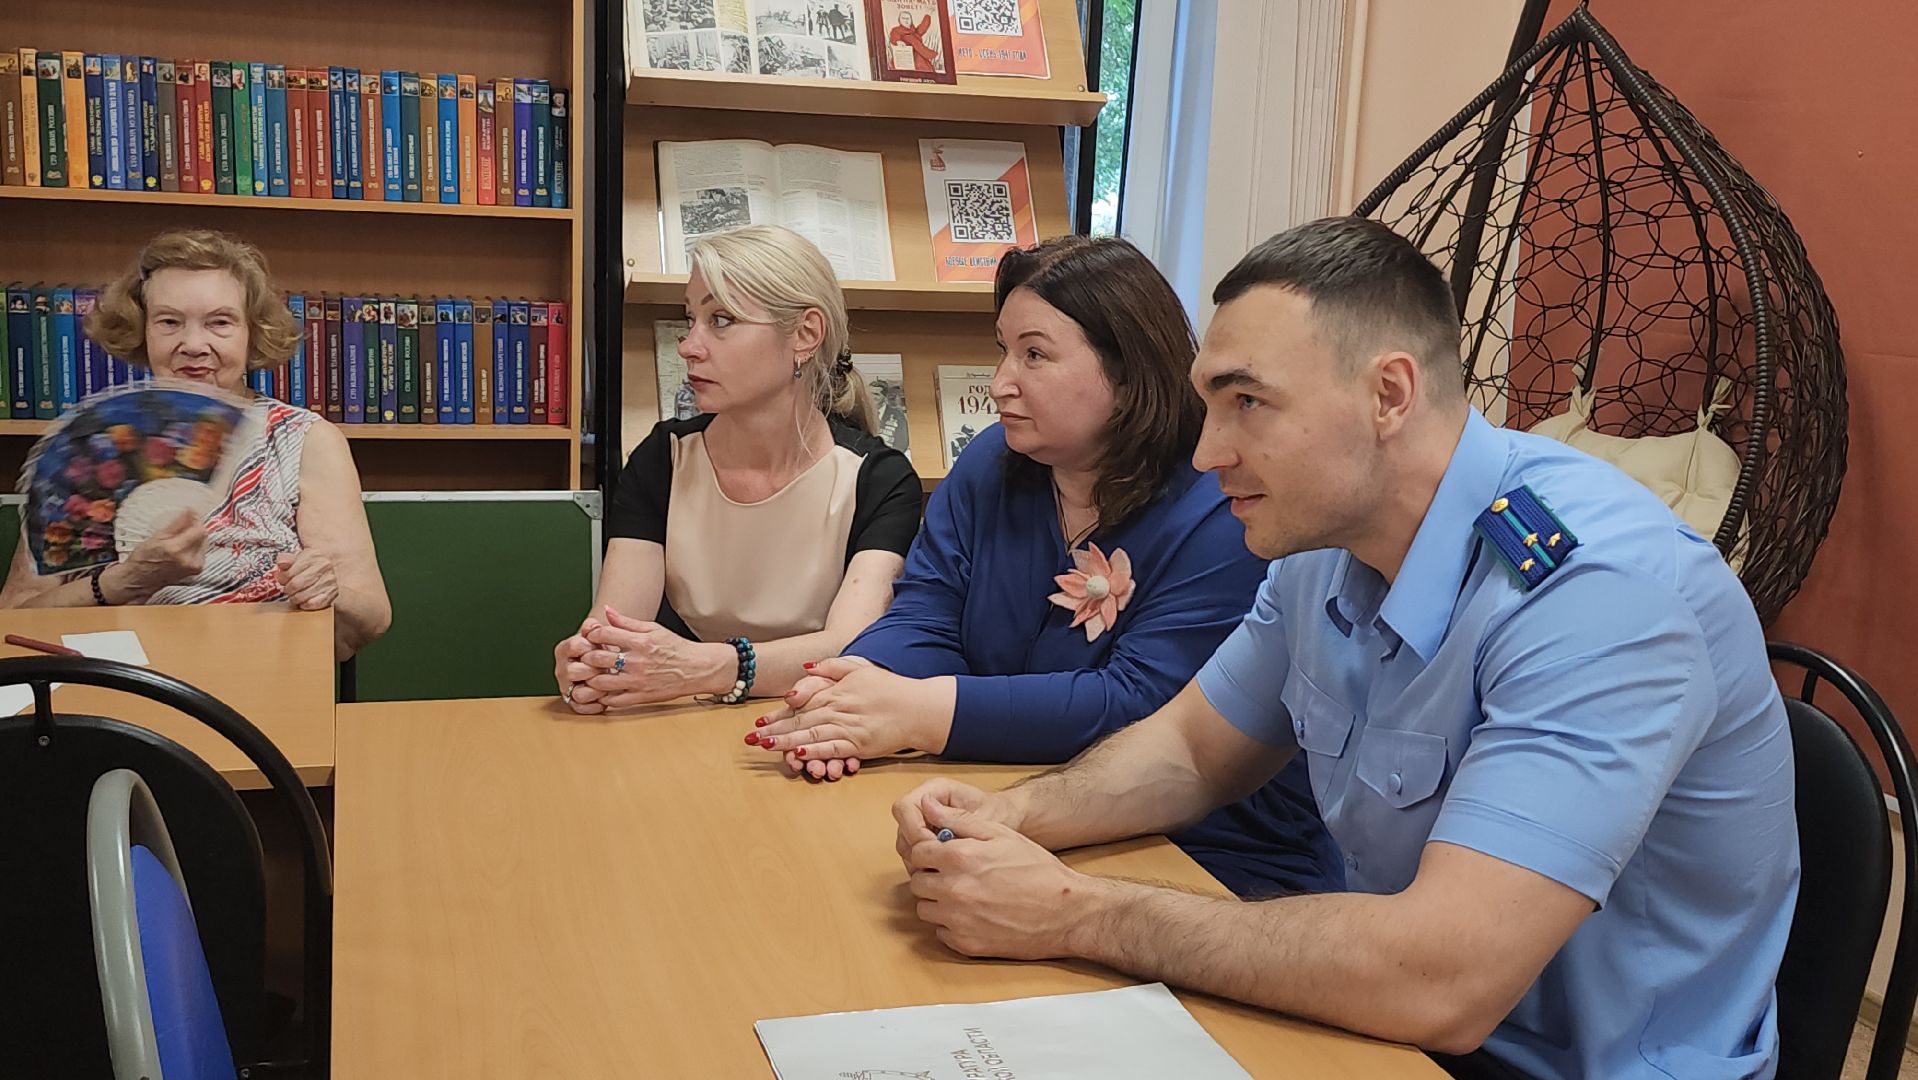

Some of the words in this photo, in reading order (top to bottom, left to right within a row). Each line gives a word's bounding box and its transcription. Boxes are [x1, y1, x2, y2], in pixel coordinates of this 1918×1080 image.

[959, 395, 999, 415] 194
[962, 1027, 1004, 1065] ОБЛАСТИ
[950, 1049, 986, 1080] РАТУРА
